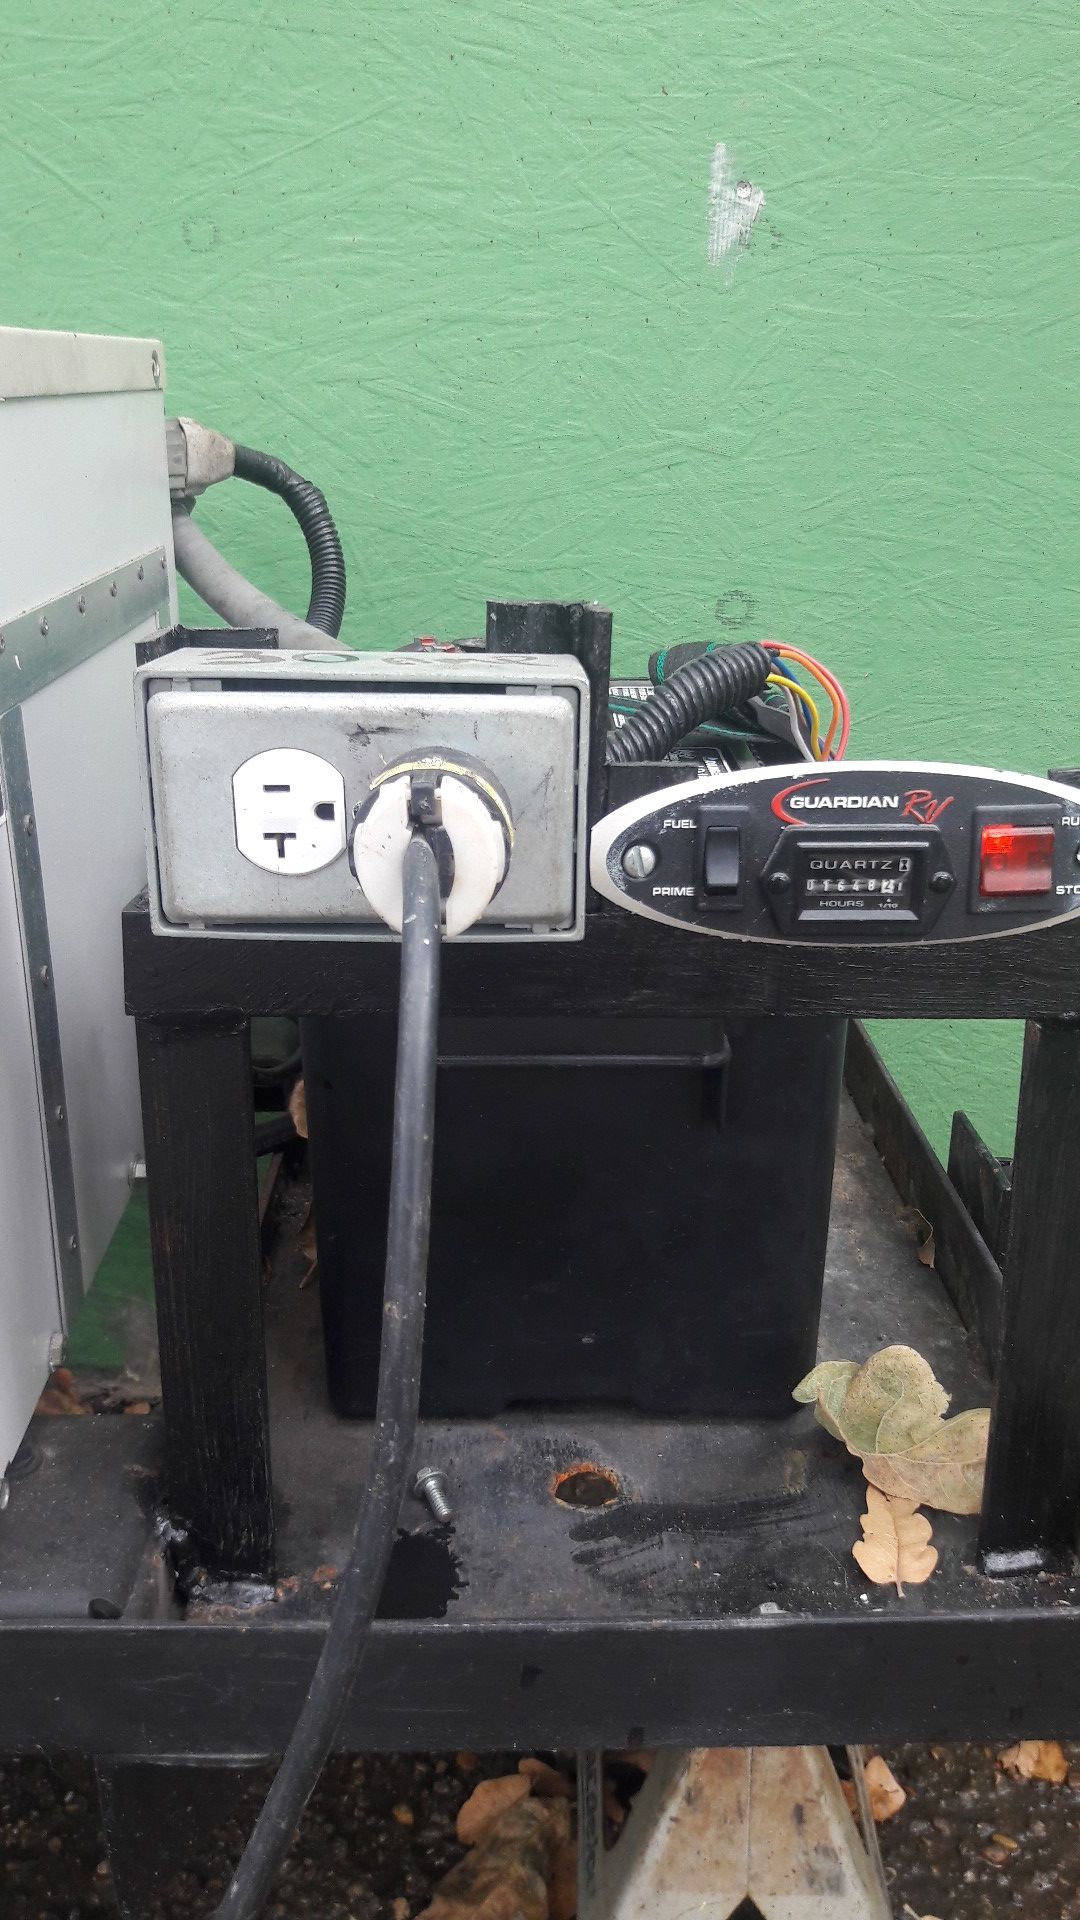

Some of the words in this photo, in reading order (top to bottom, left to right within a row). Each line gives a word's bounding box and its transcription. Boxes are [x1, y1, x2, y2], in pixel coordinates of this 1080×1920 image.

[197, 650, 361, 666] 30
[789, 795, 899, 809] GUARDIAN
[900, 789, 955, 824] RV
[663, 819, 697, 829] FUEL
[1061, 816, 1080, 826] RU
[810, 860, 893, 870] QUARTZ
[652, 887, 695, 897] PRIME
